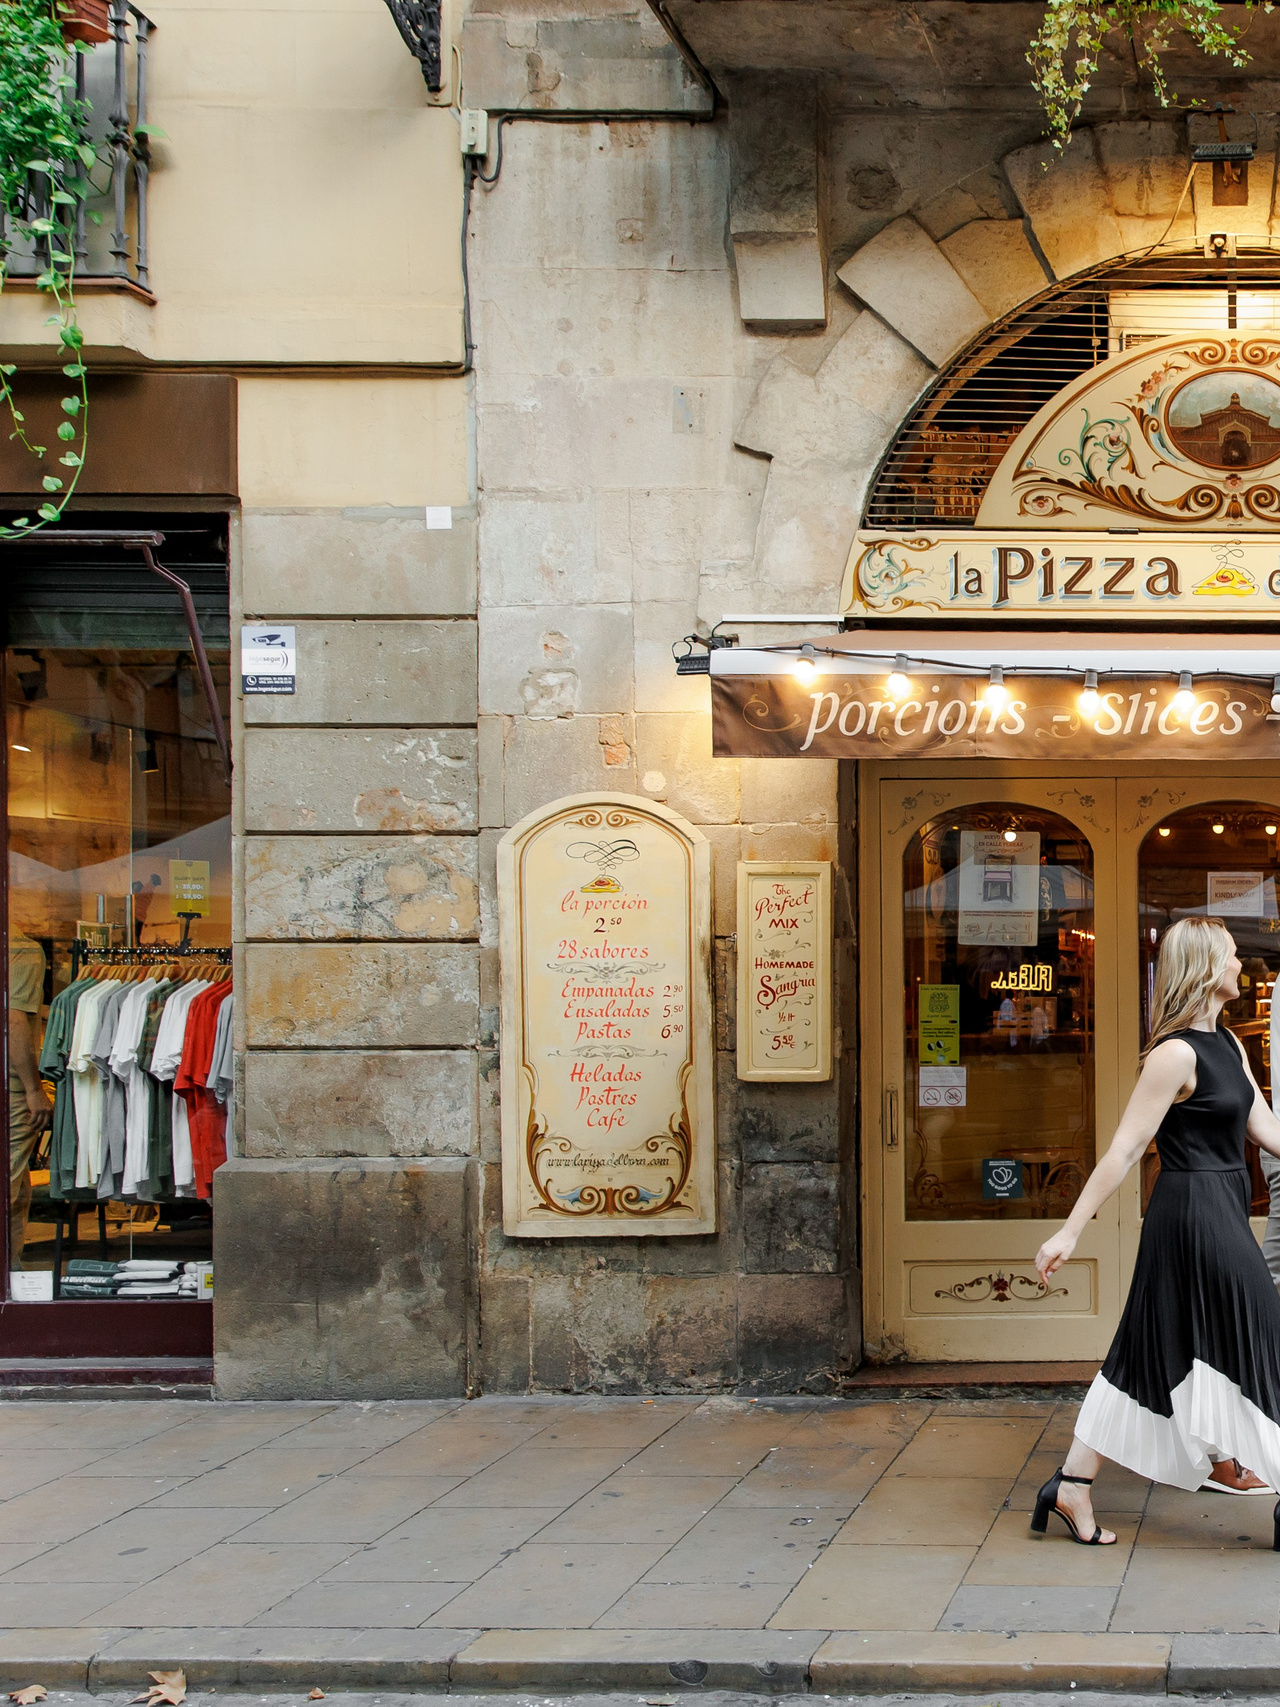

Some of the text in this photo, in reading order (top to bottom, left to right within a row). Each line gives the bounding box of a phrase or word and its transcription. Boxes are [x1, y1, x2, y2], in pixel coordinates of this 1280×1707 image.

[950, 549, 984, 601] la
[991, 546, 1183, 609] Pizza
[1094, 687, 1248, 737] Slices
[772, 883, 791, 896] The
[582, 892, 649, 919] porción
[754, 889, 815, 922] Perfect
[768, 918, 800, 929] MIX
[557, 939, 650, 959] 28 sabores
[561, 976, 655, 1004] Empanadas
[563, 998, 651, 1019] Ensaladas
[575, 1021, 632, 1045] Pastas
[586, 1108, 631, 1135] Cafe
